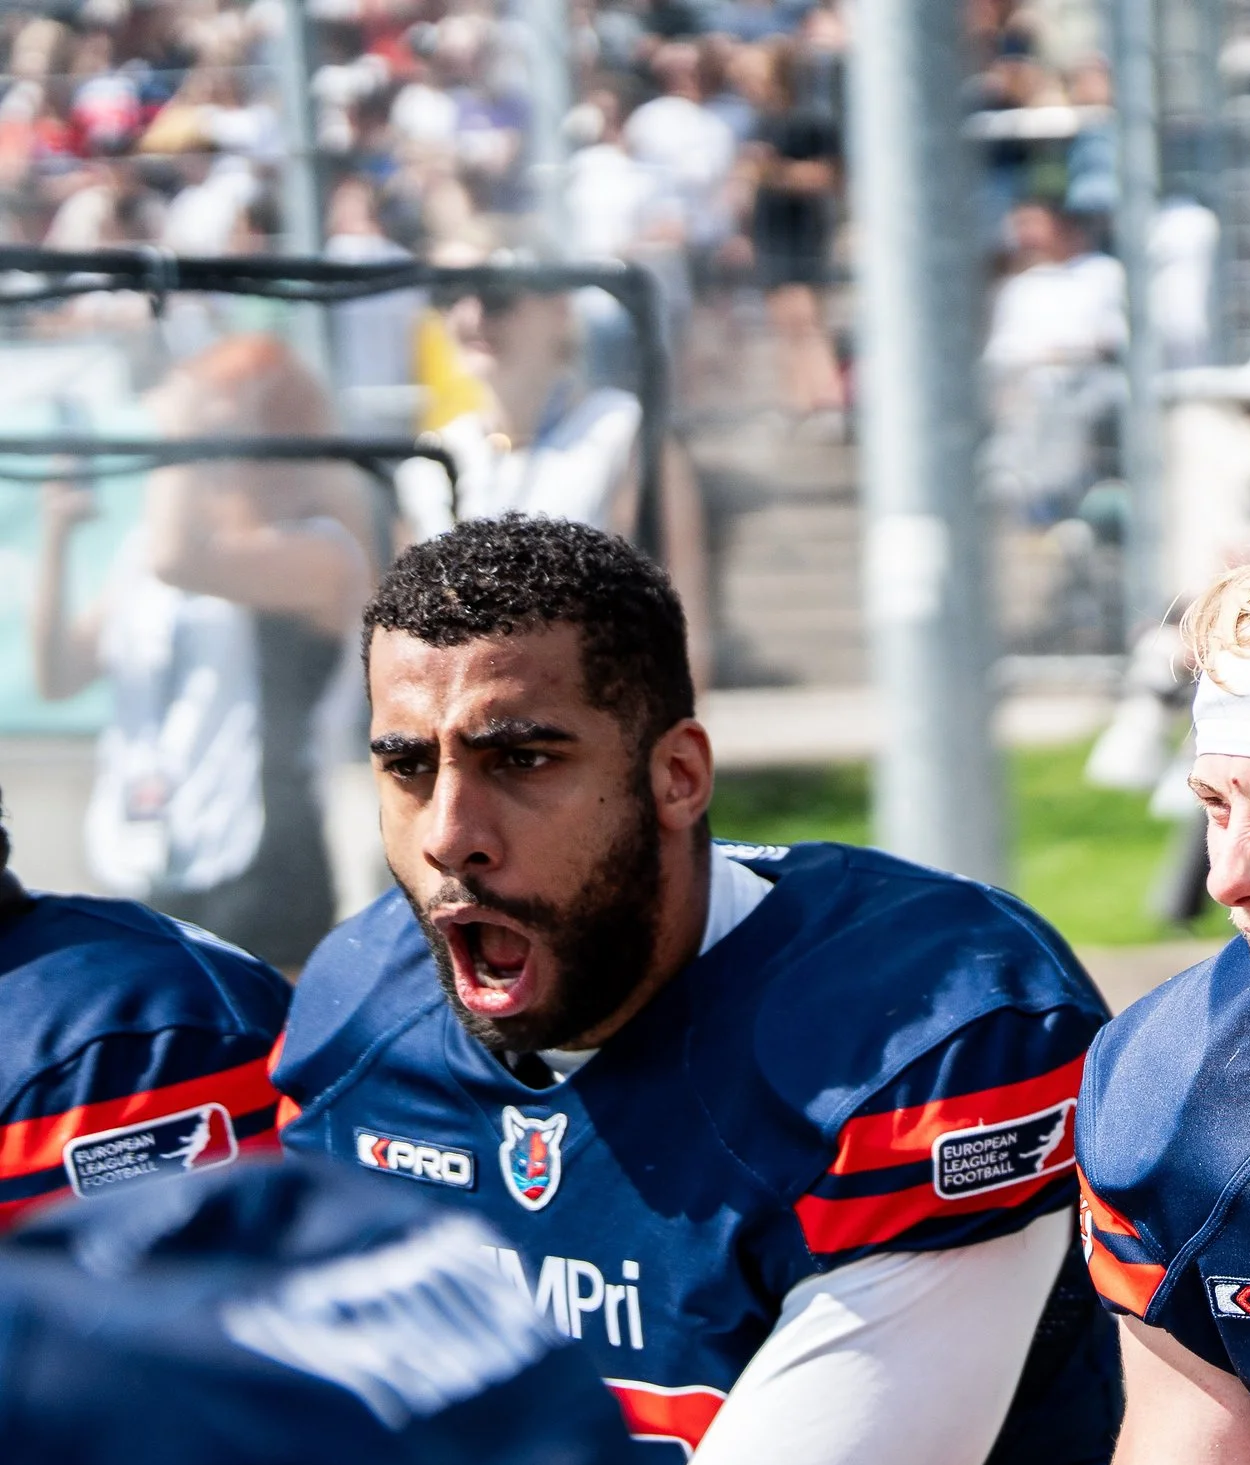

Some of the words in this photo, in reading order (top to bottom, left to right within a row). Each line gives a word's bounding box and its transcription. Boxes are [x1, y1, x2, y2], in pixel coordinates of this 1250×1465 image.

[74, 1132, 156, 1164] EUROPEAN
[943, 1132, 1018, 1159] EUROPEAN
[78, 1152, 136, 1177] LEAGUE
[81, 1161, 160, 1188] FOOTBALL
[943, 1153, 998, 1174] LEAGUE
[944, 1160, 1015, 1187] FOOTBALL
